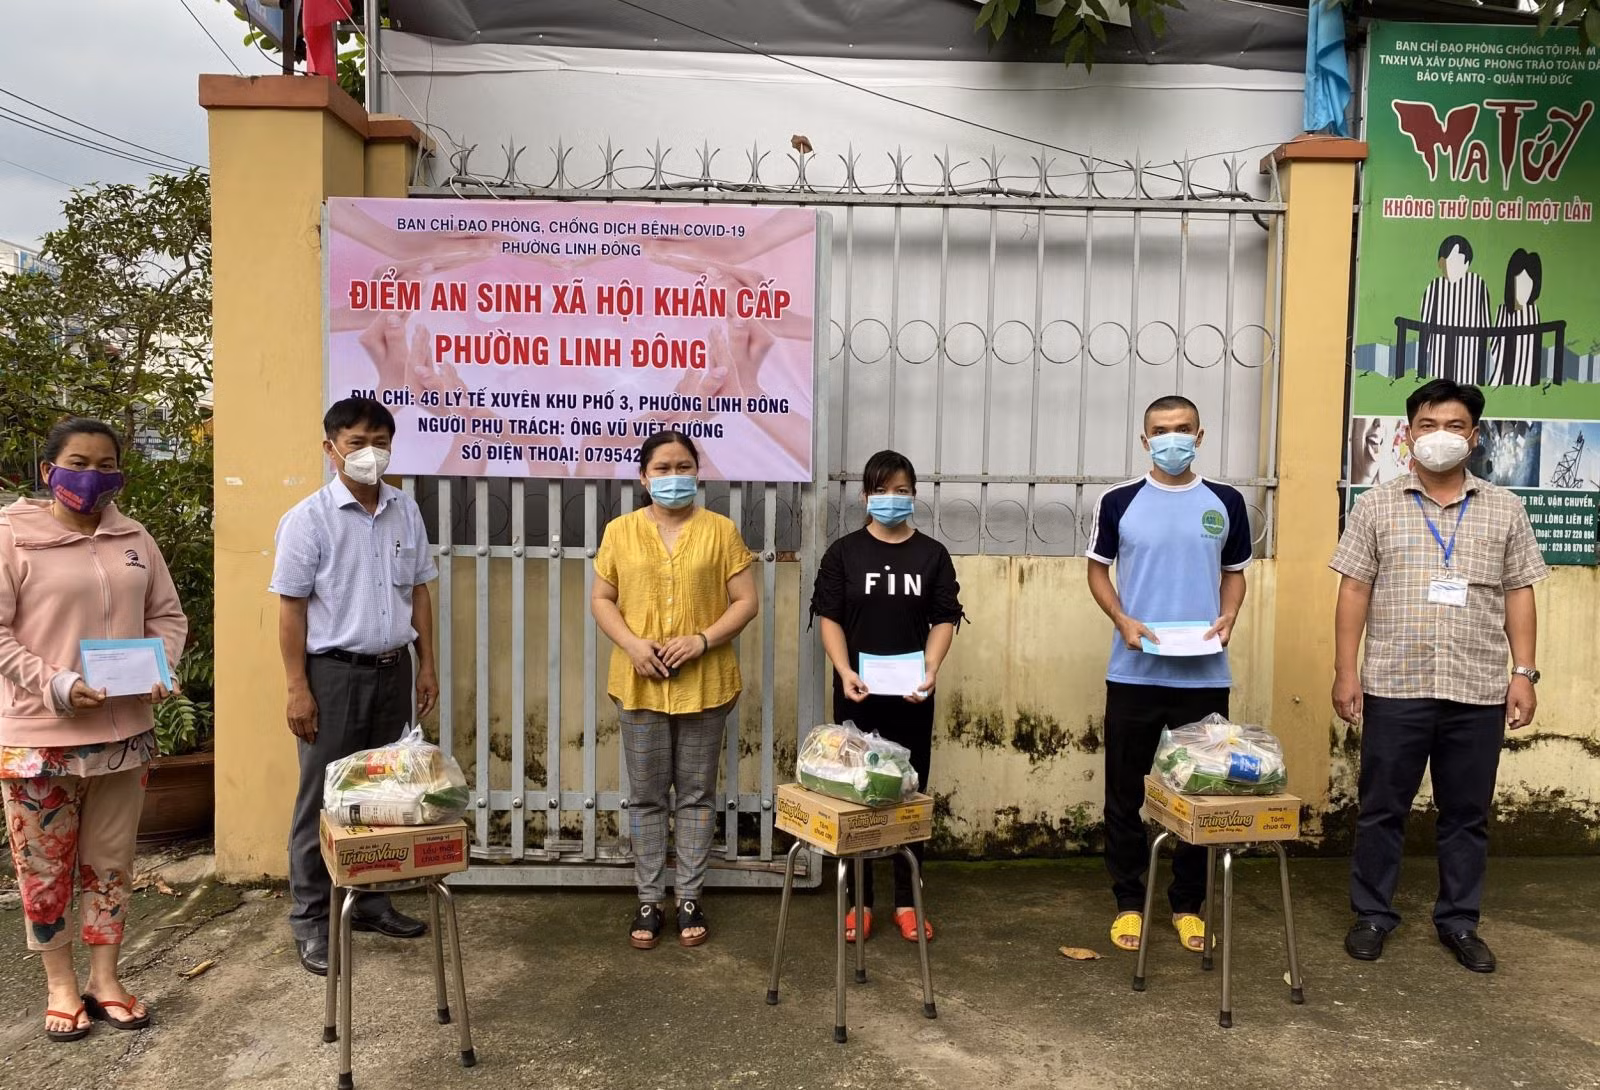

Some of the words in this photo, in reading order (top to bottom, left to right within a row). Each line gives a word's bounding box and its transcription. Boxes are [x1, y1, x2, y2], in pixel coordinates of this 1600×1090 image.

[1396, 40, 1418, 51] BAN
[1420, 40, 1438, 52] CHỈ
[1440, 43, 1463, 55] ĐẠO
[1465, 42, 1504, 54] PHÒNG
[1506, 42, 1544, 54] CHỐNG
[1565, 46, 1596, 56] PHM
[1379, 54, 1408, 66] TNXH
[1410, 55, 1424, 66] VÀ
[1426, 56, 1446, 67] XÂY
[1448, 57, 1480, 70] DỰNG
[1416, 69, 1438, 82] BẢO
[1440, 70, 1454, 84] VỆ
[1456, 73, 1486, 84] ANTQ
[1493, 72, 1524, 86] QUẬN
[1526, 72, 1547, 84] THỦ
[1549, 73, 1573, 84] ĐỨC
[1384, 196, 1434, 218] KHÔNG
[1497, 196, 1522, 220] CHỈ
[1526, 198, 1560, 224] MỘT
[397, 218, 426, 230] BAN
[430, 215, 454, 231] CHỈ
[458, 219, 488, 234] ĐẠO
[491, 218, 545, 234] PHÒNG,
[549, 216, 599, 234] CHỐNG
[603, 222, 636, 236] DỊCH
[641, 220, 679, 237] BỆNH
[684, 224, 746, 237] COVID-19
[502, 240, 560, 254] PHƯỜNG
[565, 243, 596, 255] LINH
[601, 241, 641, 256] ĐÔNG
[349, 268, 421, 310] ĐIỂM
[430, 282, 467, 312] AN
[477, 283, 542, 313] SINH
[552, 278, 587, 314] XÃ
[597, 279, 643, 322] HỘI
[654, 275, 726, 318] KHẨN
[736, 279, 790, 319] CẤP
[434, 329, 549, 366] PHƯỜNG
[559, 337, 621, 367] LINH
[630, 332, 706, 368] ĐÔNG
[382, 386, 415, 406] CHỈ:
[420, 391, 440, 406] 46
[445, 387, 462, 407] LÝ
[468, 386, 488, 407] TẾ
[491, 390, 540, 408] XUYÊN
[546, 394, 576, 409] KHU
[582, 390, 615, 410] PHỐ
[620, 396, 634, 412] 3,
[639, 393, 702, 412] PHƯỜNG
[708, 397, 742, 413] LINH
[747, 394, 789, 414] ĐÔNG
[418, 414, 466, 433] NGƯỜI
[472, 419, 502, 437] PHỤ
[509, 416, 565, 435] TRÁCH:
[570, 418, 602, 436] ÔNG
[607, 420, 627, 437] VŨ
[462, 440, 483, 460] SỐ
[487, 442, 523, 464] ĐIỆN
[528, 446, 578, 464] THOẠI:
[1530, 514, 1542, 524] VUI
[1545, 512, 1564, 524] LÒNG
[1566, 513, 1582, 524] LIÊN
[1584, 514, 1594, 526] HỆ
